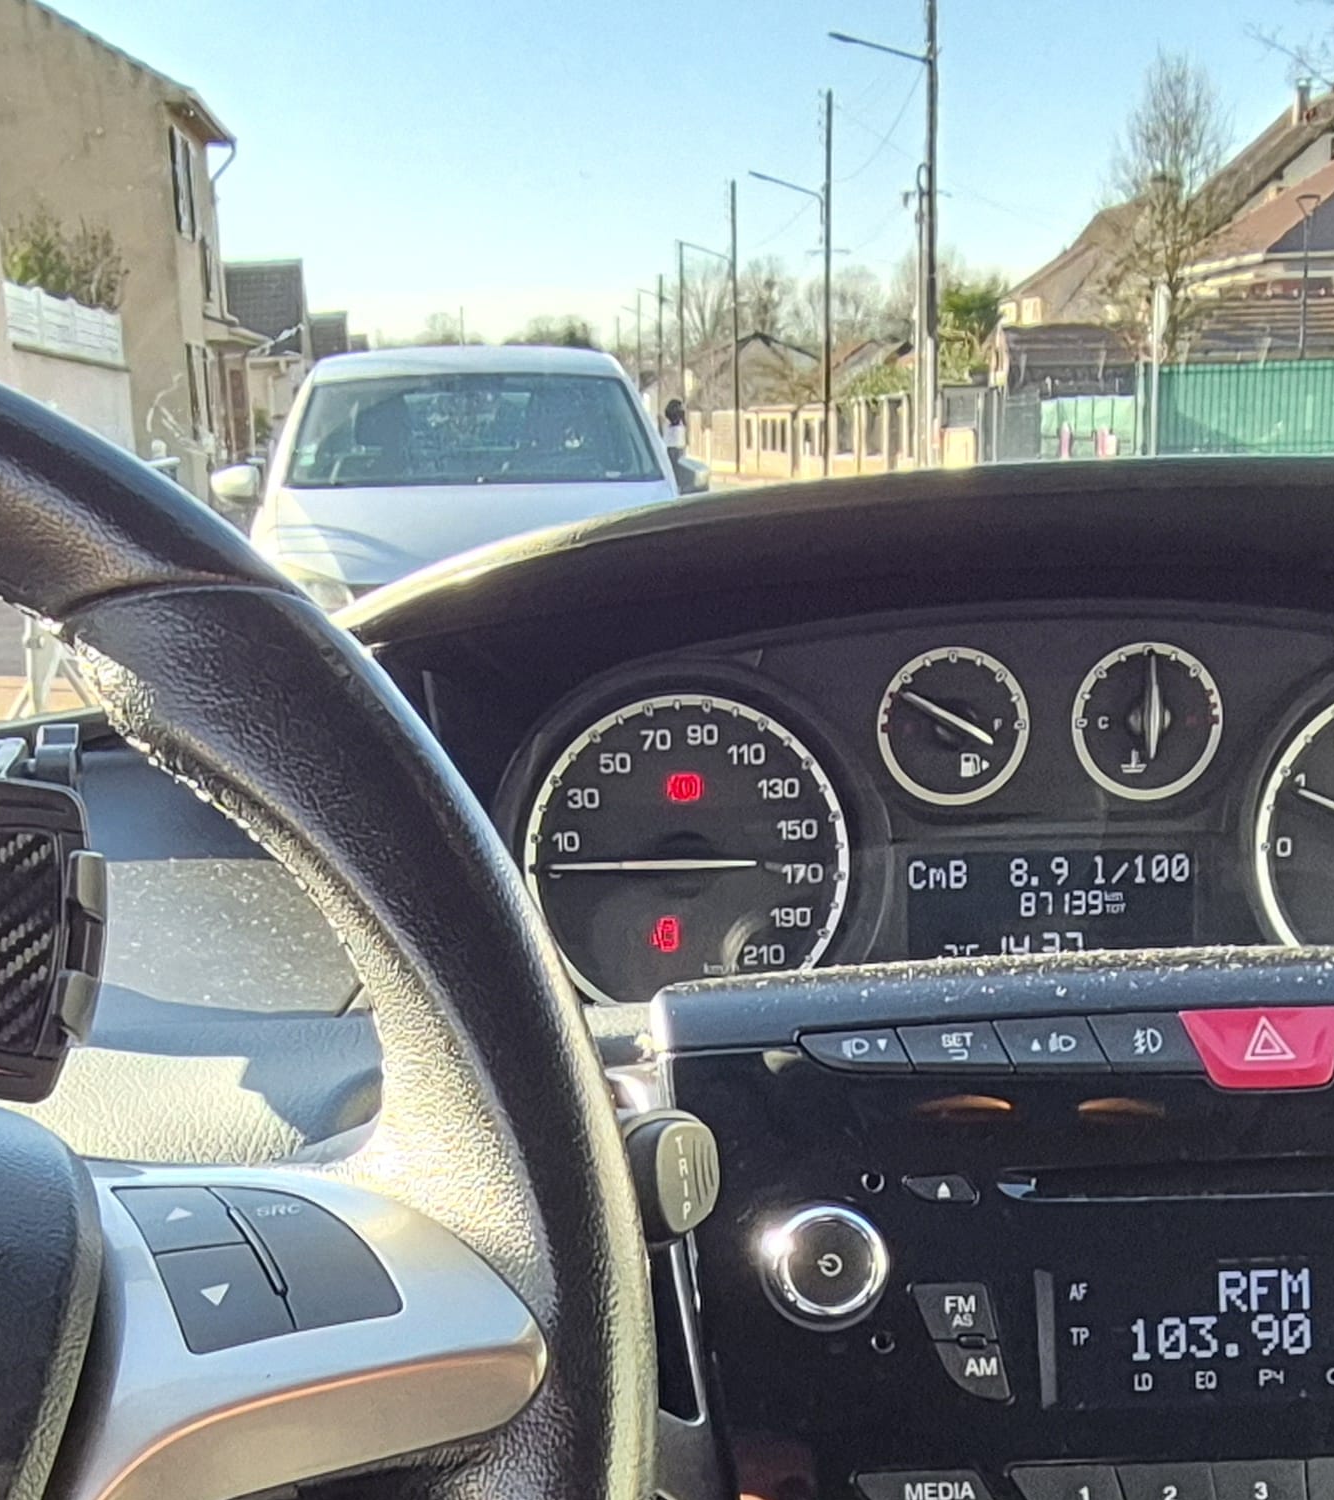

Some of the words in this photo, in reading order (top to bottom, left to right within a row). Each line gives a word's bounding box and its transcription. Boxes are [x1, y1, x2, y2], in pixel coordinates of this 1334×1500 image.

[640, 729, 672, 751] 70
[686, 724, 719, 746] 90
[599, 752, 632, 774] 50
[727, 743, 766, 766] 110
[757, 776, 801, 799] 130
[567, 788, 601, 810] 30
[776, 819, 819, 841] 150
[552, 831, 581, 853] 10
[1276, 837, 1293, 858] 0
[781, 862, 824, 885] 170
[908, 859, 968, 891] CmB
[1019, 890, 1103, 917] 87139
[770, 906, 812, 928] 190
[743, 943, 785, 966] 210
[674, 1134, 693, 1221] TRIP
[257, 1203, 301, 1217] SRC
[1069, 1282, 1089, 1301] AF
[1217, 1267, 1311, 1312] RFM
[944, 1294, 976, 1315] FM
[952, 1312, 974, 1329] AS
[1069, 1326, 1090, 1346] TP
[1130, 1312, 1312, 1362] 103.90
[964, 1356, 999, 1377] AM
[1254, 1481, 1269, 1500] 3
